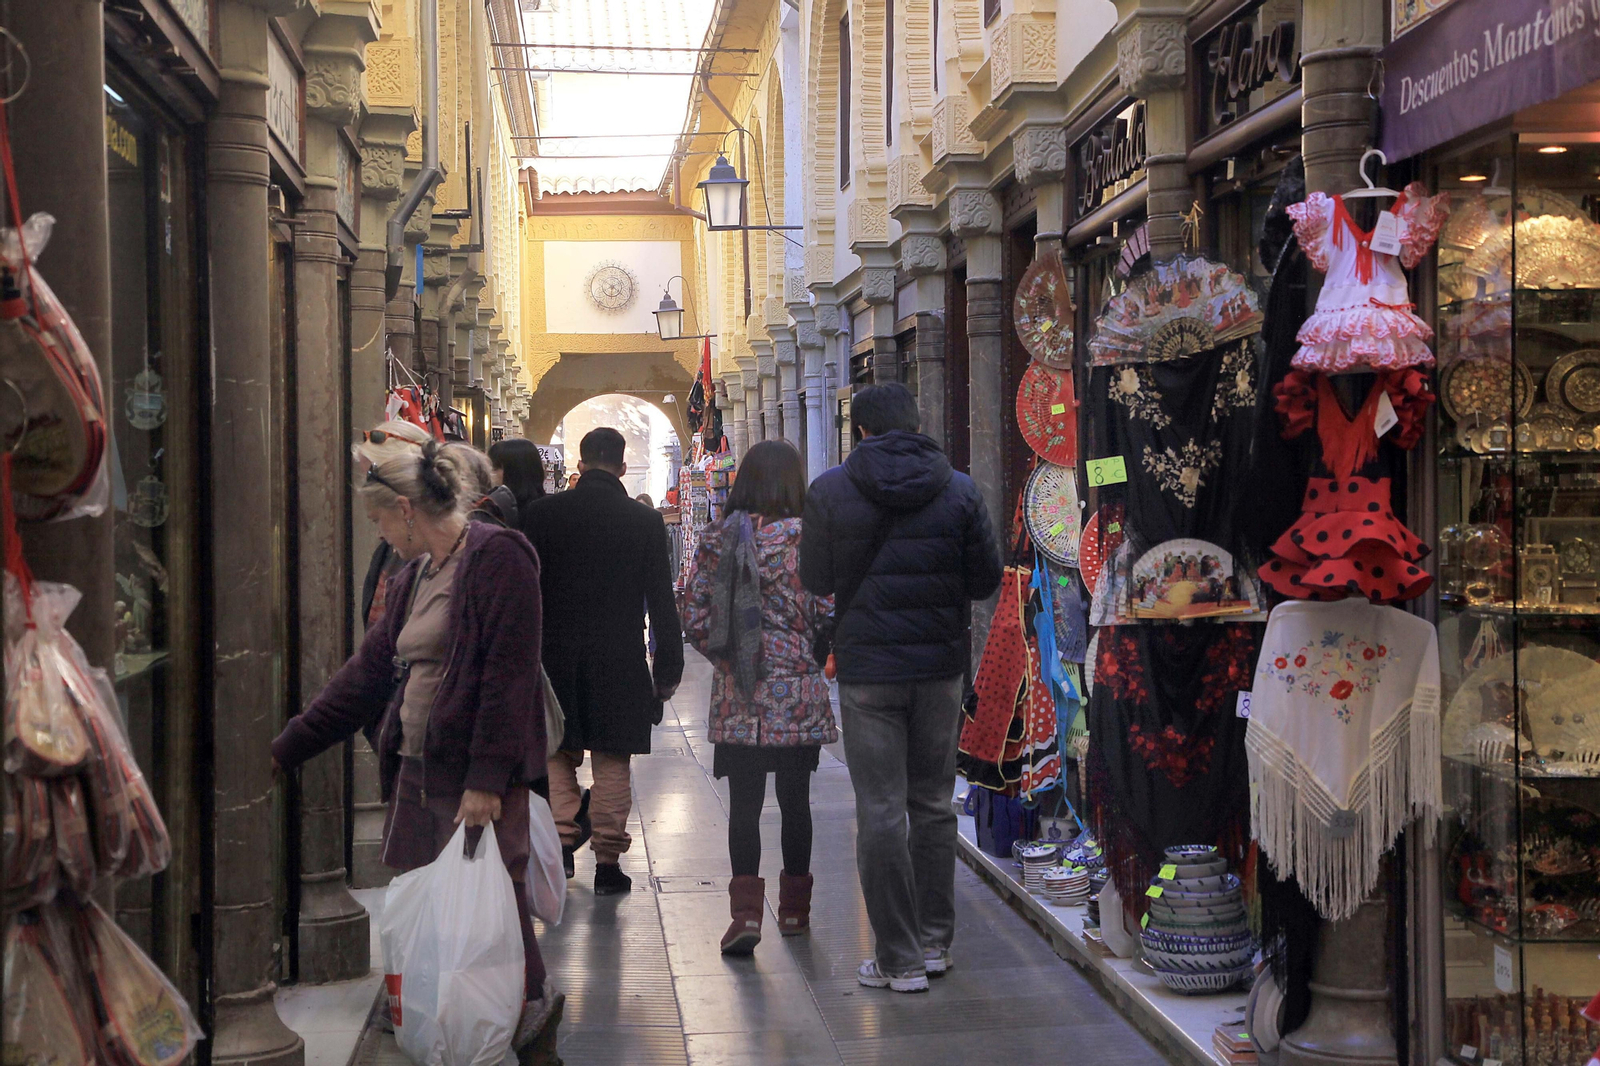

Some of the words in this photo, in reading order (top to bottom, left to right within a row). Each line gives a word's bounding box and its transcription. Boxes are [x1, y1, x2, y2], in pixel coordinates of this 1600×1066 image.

[1208, 22, 1302, 125] Elena
[1400, 49, 1479, 115] Descuentos
[1483, 0, 1585, 72] Mantones
[1094, 466, 1104, 485] 8
